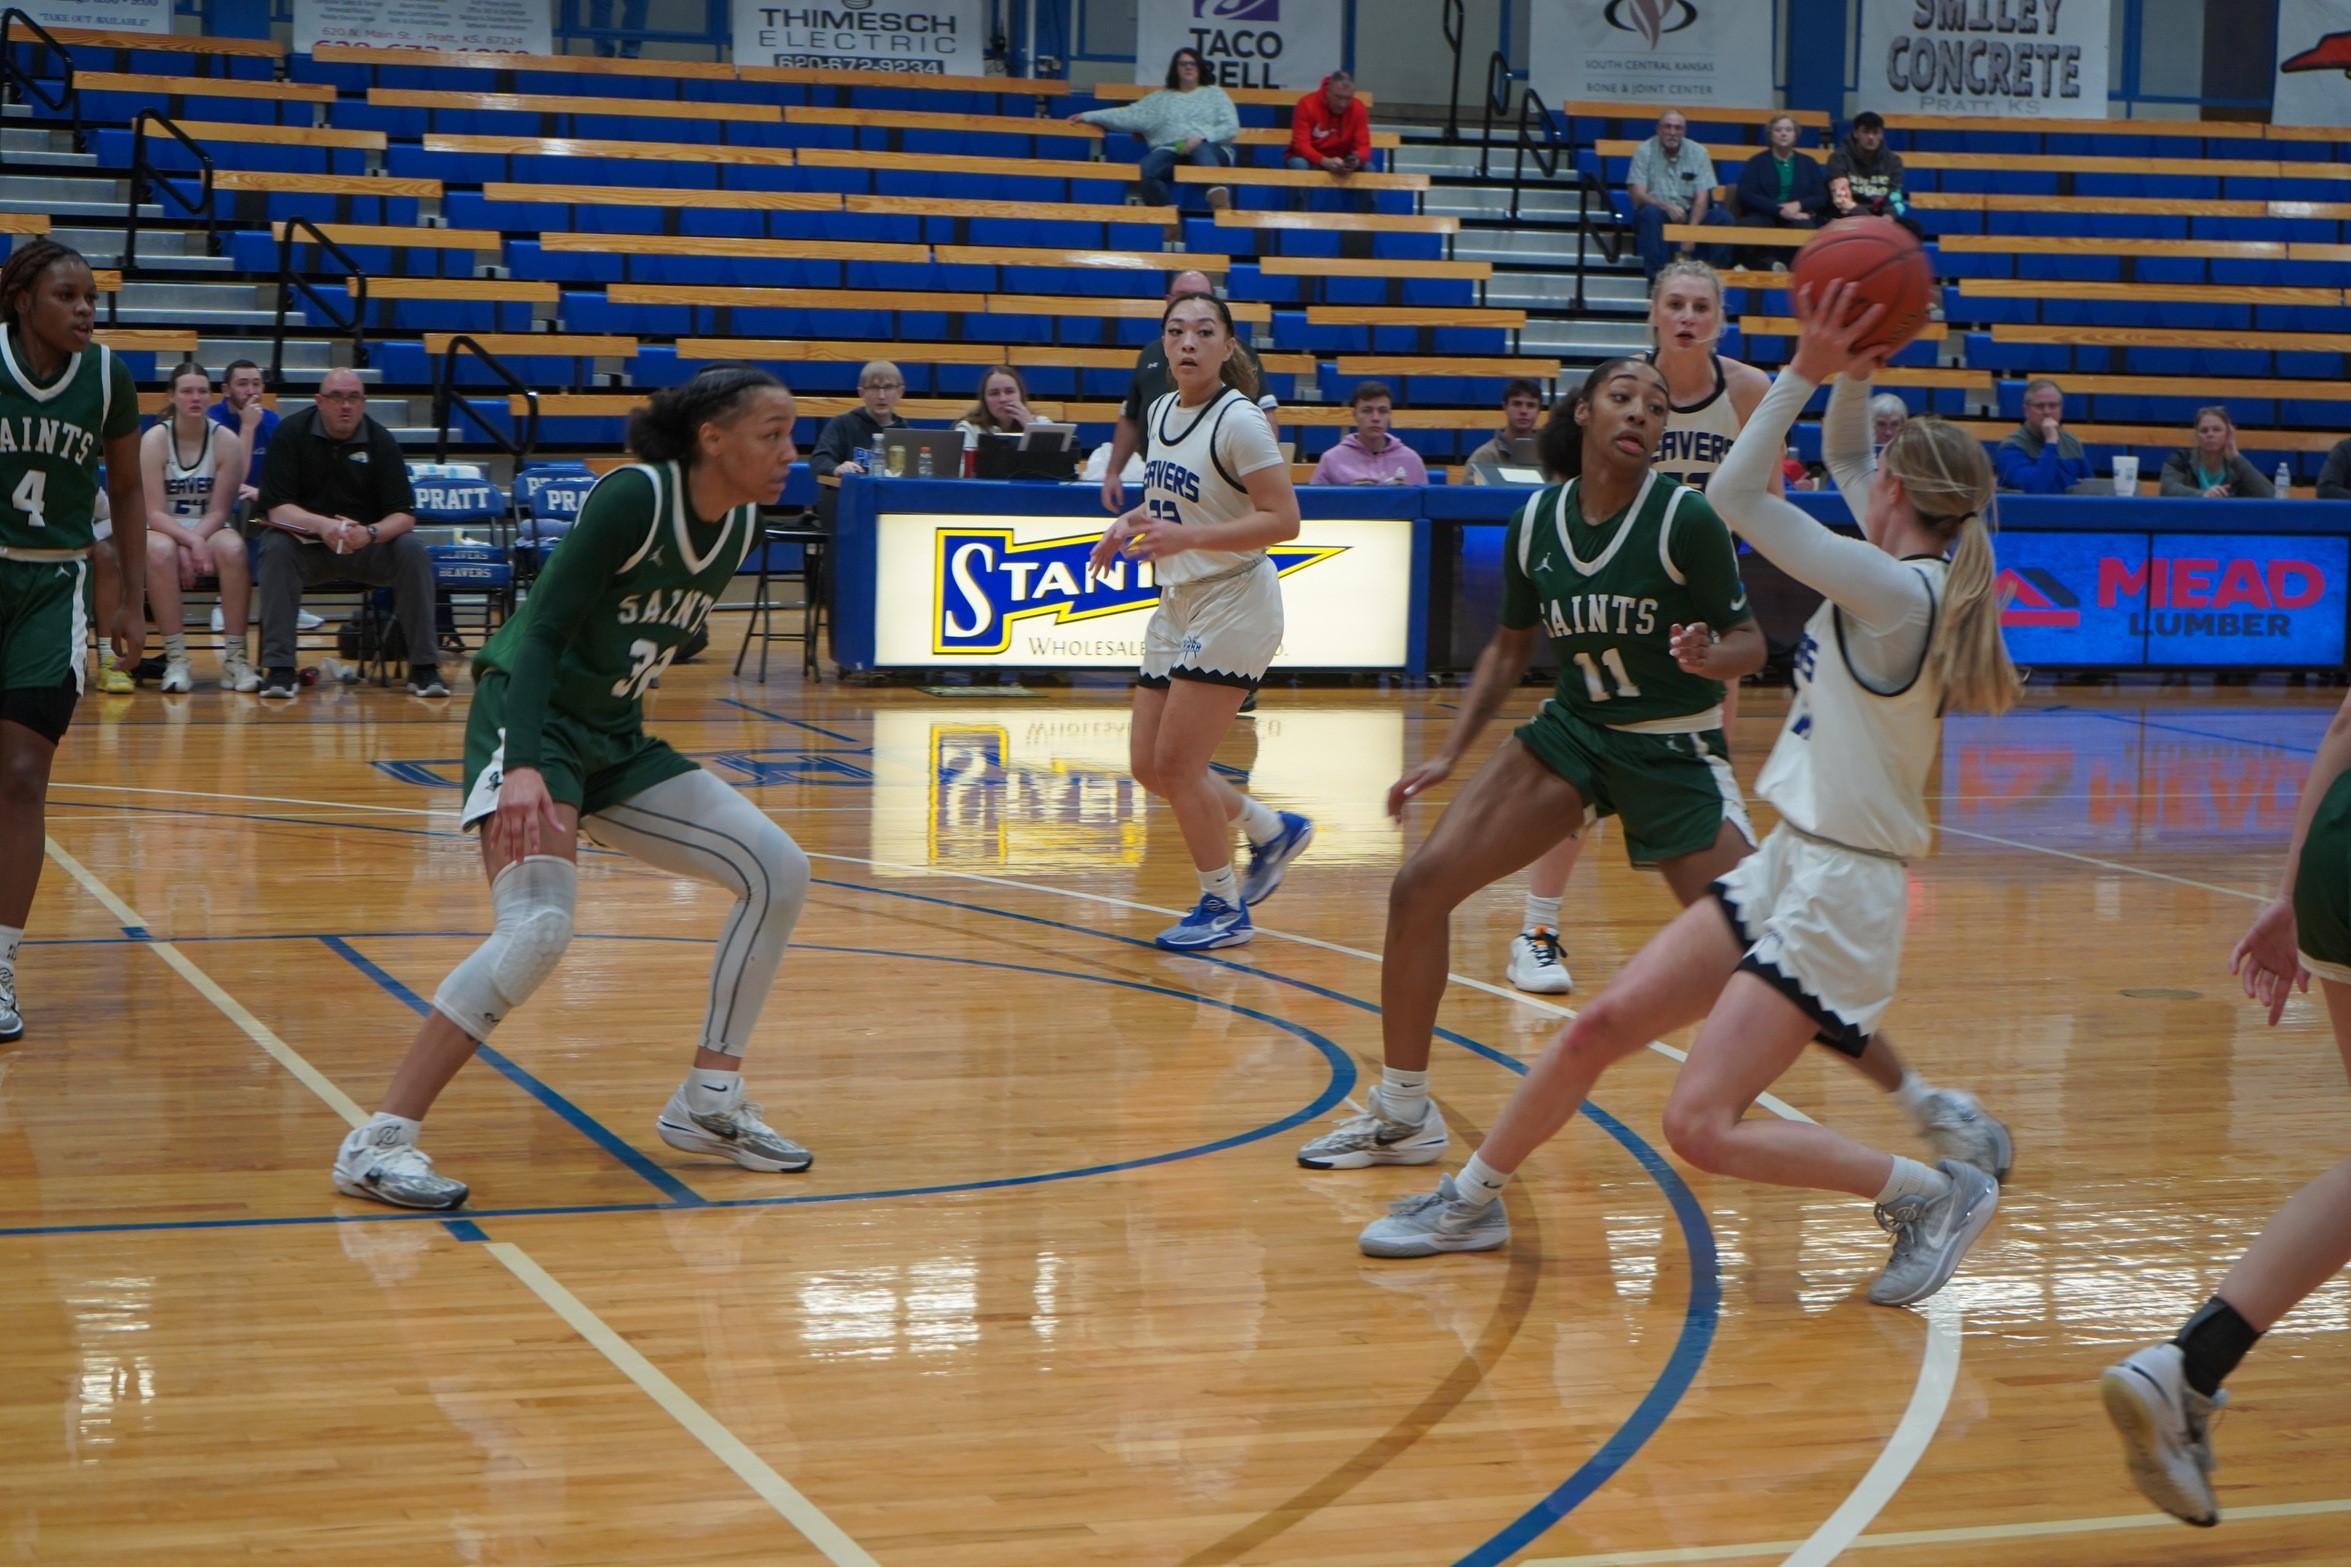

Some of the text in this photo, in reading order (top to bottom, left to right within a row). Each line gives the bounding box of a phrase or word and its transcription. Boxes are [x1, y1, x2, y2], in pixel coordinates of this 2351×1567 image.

[322, 27, 346, 36] 620
[365, 30, 393, 38] Main
[758, 8, 957, 35] THIMESCH
[759, 30, 957, 54] ELECTRIC
[1189, 28, 1283, 59] TACO
[778, 56, 940, 74] 620-672-9234
[1585, 59, 1715, 72] SOUTH CENTRAL KANSAS
[1887, 35, 2081, 98] CONCRETE
[1586, 82, 1713, 95] BONE & JOINT CENTER
[2009, 99, 2041, 114] KS
[0, 416, 94, 466] AINTS
[12, 469, 47, 528] 4
[415, 487, 491, 510] PRATT
[439, 567, 491, 578] BEAVERS
[2097, 556, 2326, 609] MEAD
[617, 588, 715, 636] SAINT
[2129, 613, 2291, 638] LUMBER
[1572, 648, 1642, 702] 11
